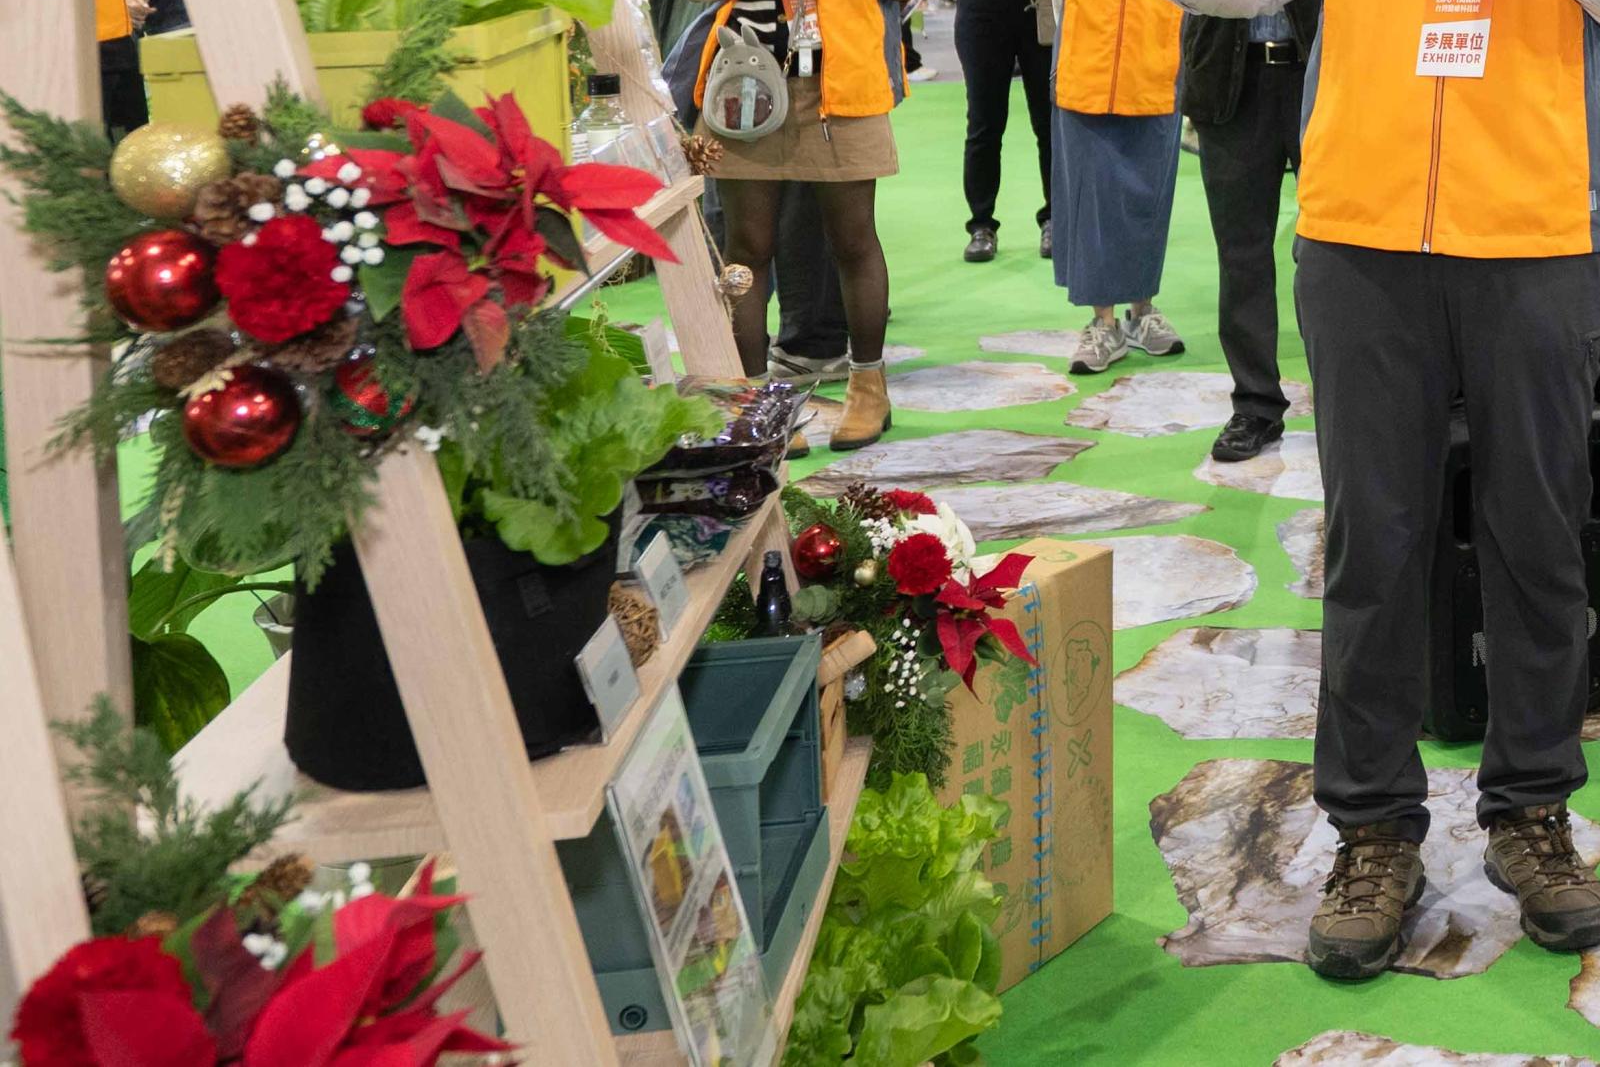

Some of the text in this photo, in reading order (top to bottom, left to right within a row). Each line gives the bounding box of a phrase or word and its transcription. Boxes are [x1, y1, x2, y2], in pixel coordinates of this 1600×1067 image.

[1424, 32, 1484, 50] 參展單位
[1422, 52, 1481, 64] EXHIBITOR
